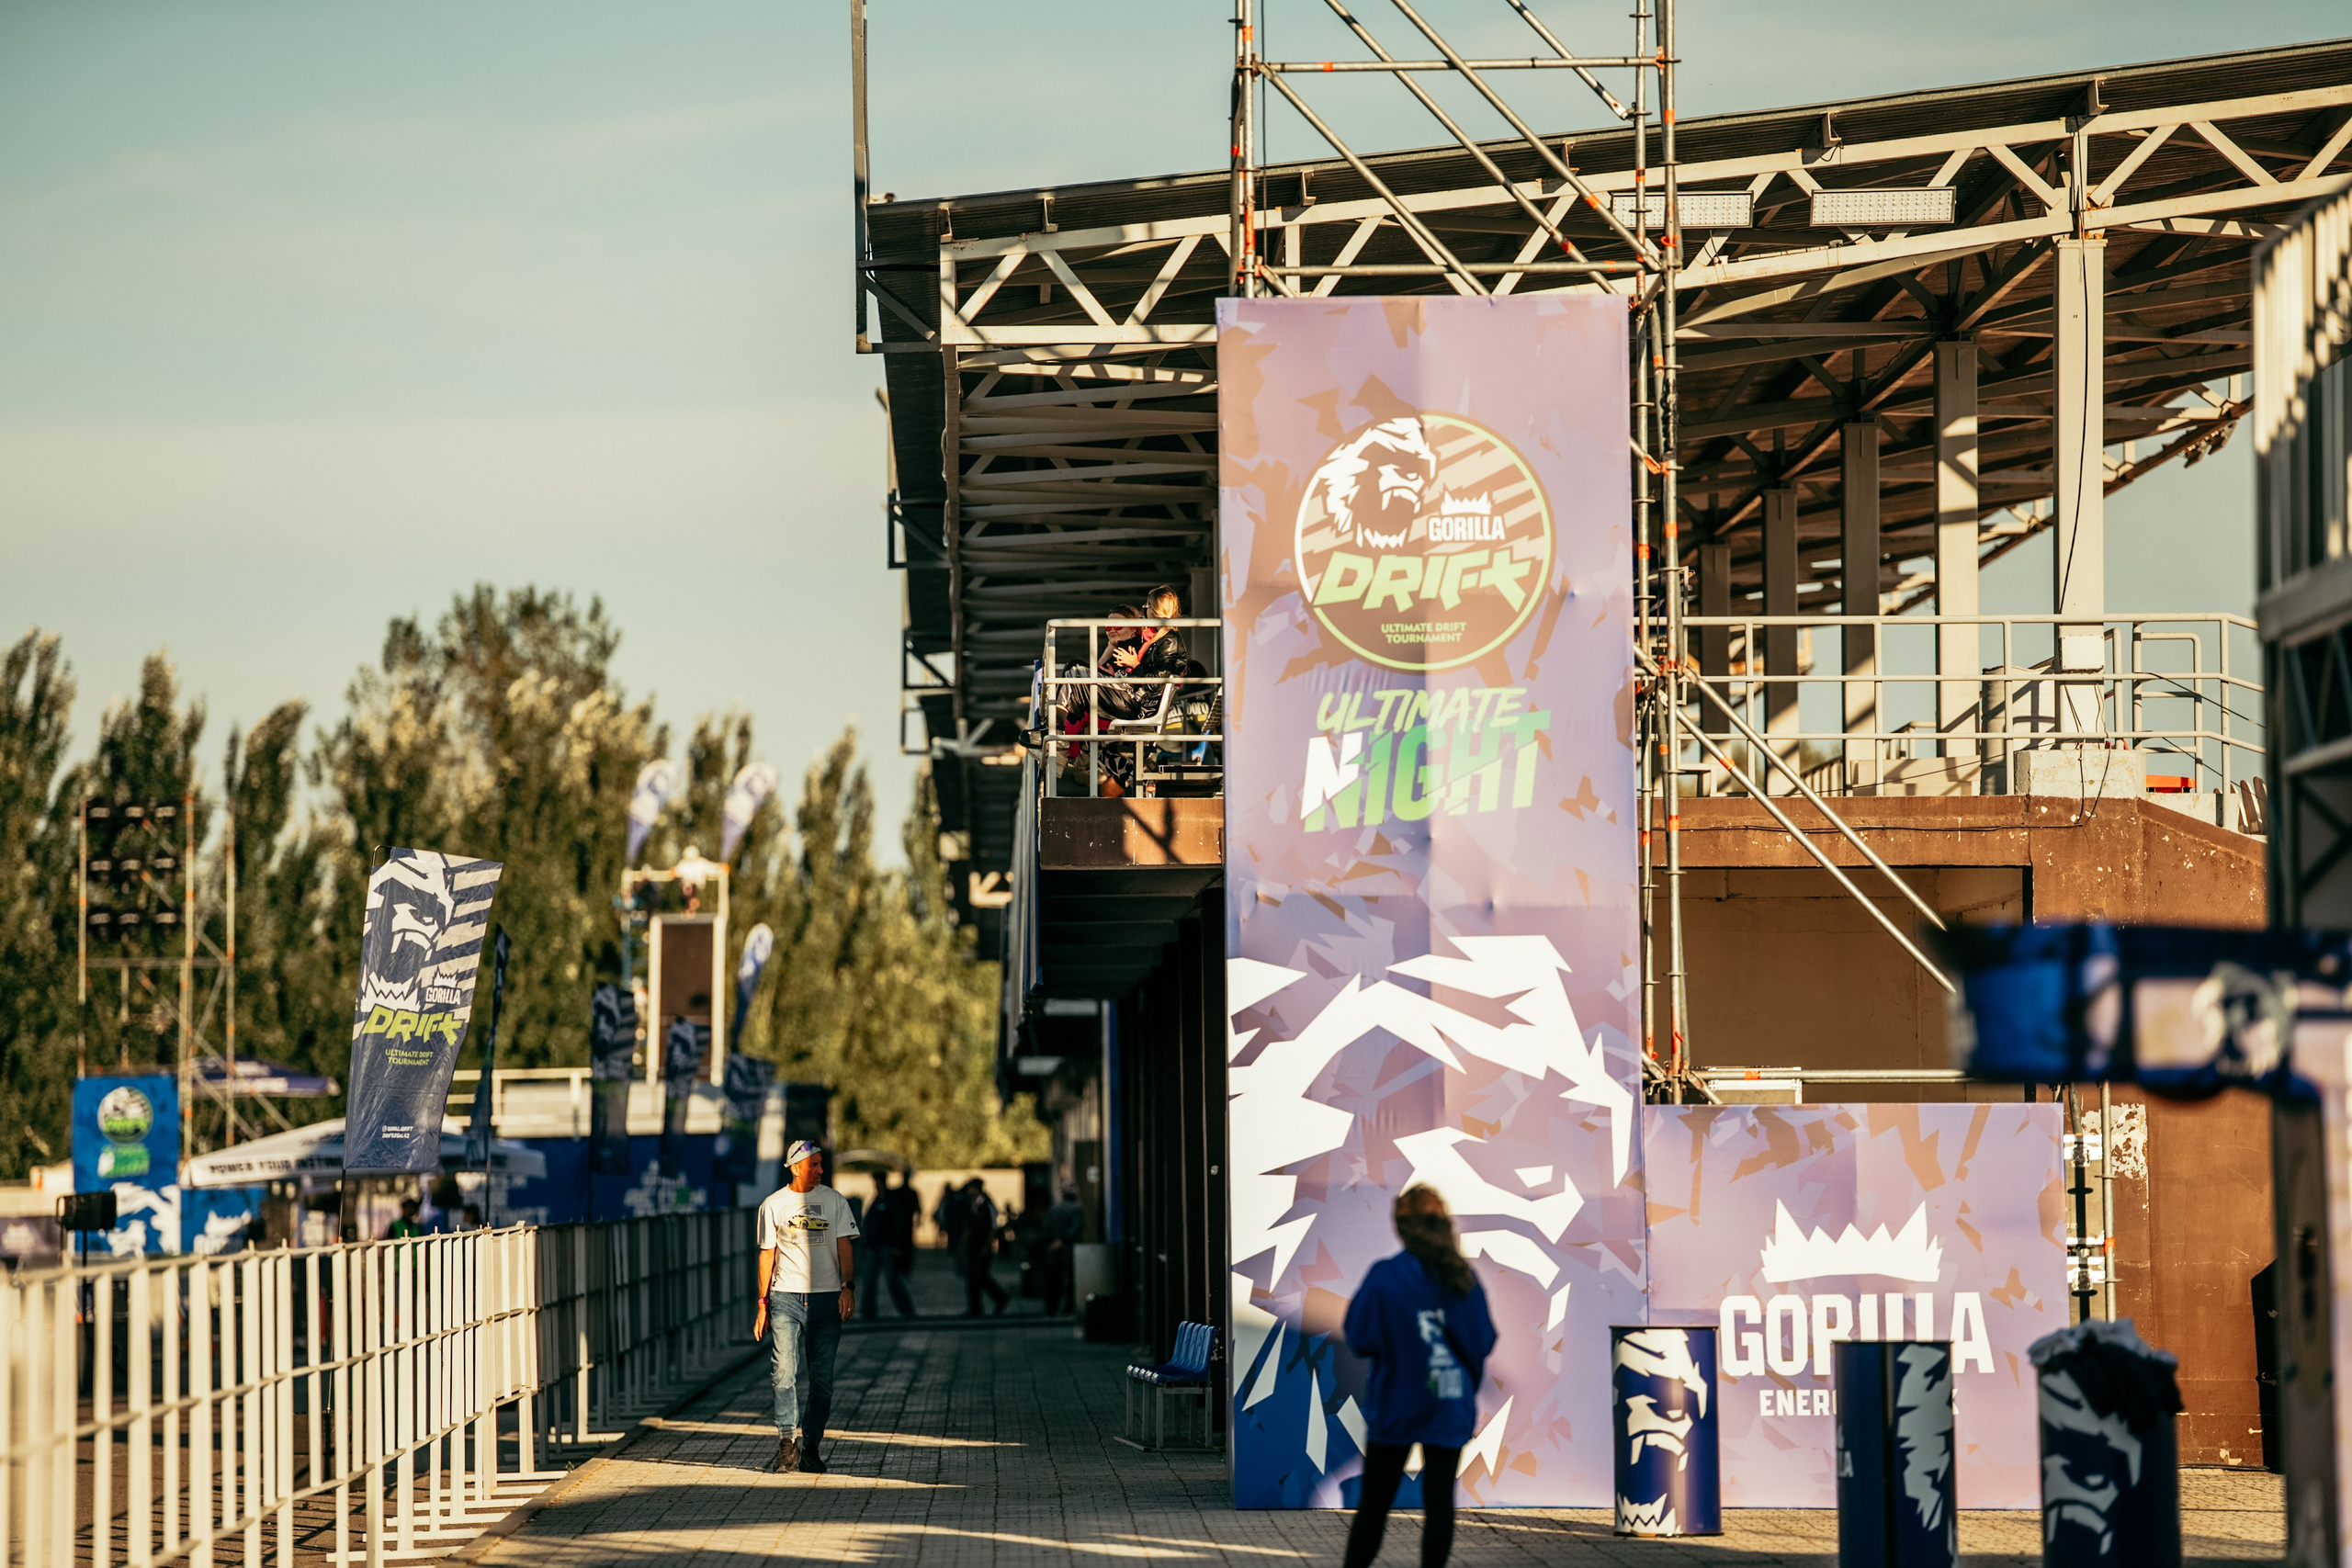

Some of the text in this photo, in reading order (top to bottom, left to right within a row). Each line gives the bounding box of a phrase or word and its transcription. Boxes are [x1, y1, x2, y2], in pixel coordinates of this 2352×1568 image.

[1428, 515, 1506, 542] GORILLA
[1313, 549, 1532, 613] DRIFT
[1381, 622, 1467, 634] ULTIMATE DRIFT
[1385, 632, 1463, 644] TOURNAMENT
[1317, 686, 1527, 735] ULTIMATE
[1300, 709, 1552, 833] NIGHT
[425, 987, 461, 1005] GORILLA
[362, 1005, 463, 1046] DRIFT
[385, 1049, 418, 1058] ULTIMATE
[388, 1056, 430, 1066] TOURNAMENT
[1759, 1388, 1837, 1416] ENER
